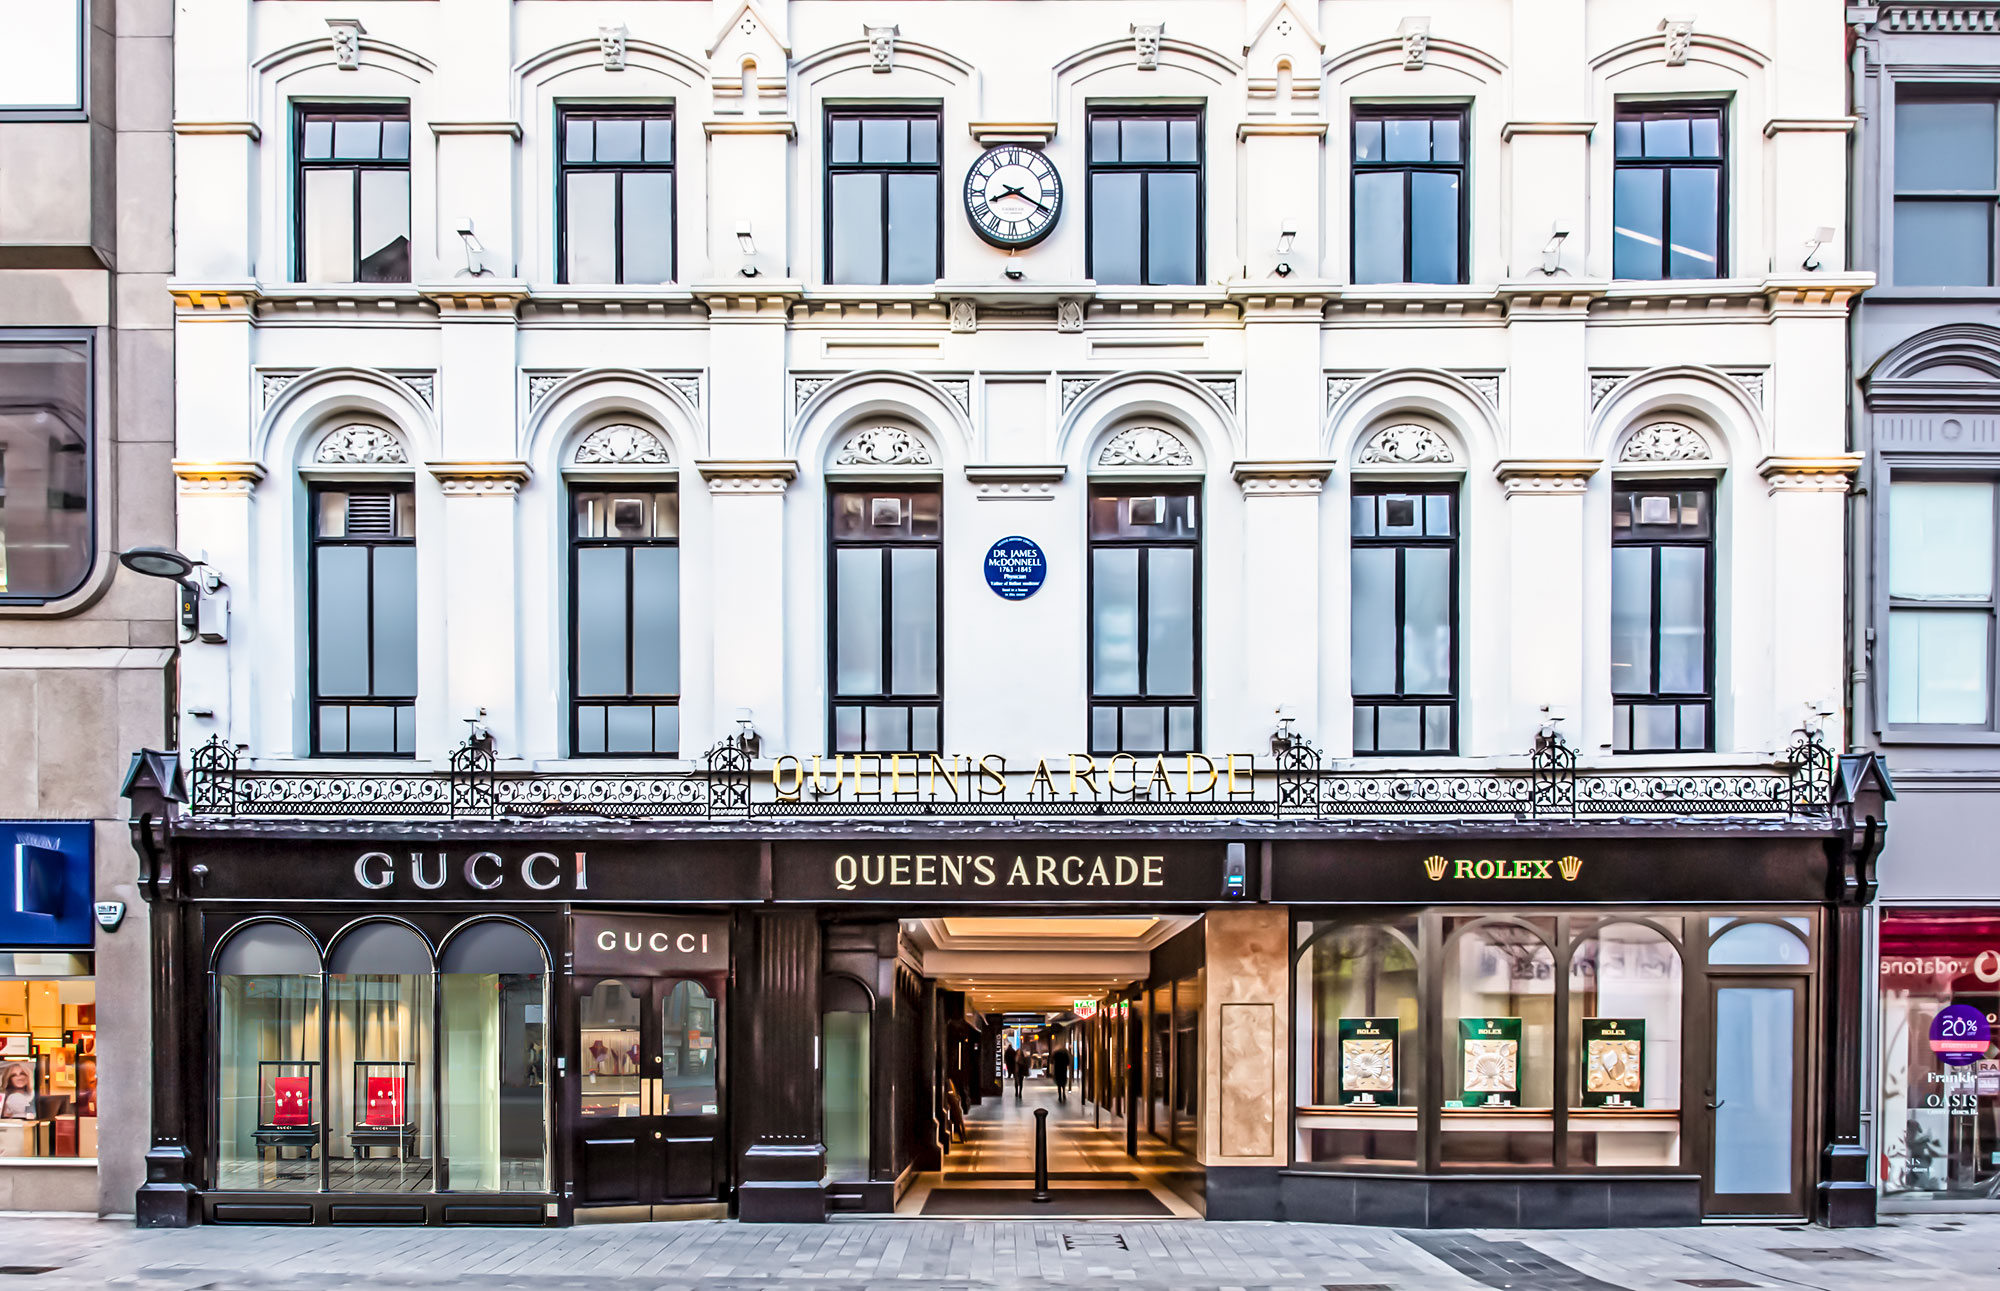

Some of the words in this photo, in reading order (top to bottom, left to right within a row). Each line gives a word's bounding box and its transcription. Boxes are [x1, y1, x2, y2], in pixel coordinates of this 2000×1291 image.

[988, 558, 1042, 566] McDONNELL
[1010, 549, 1037, 558] JAMES
[184, 603, 190, 612] 9
[773, 753, 1007, 801] QUEEN'S
[1028, 753, 1255, 796] ARCADE
[354, 852, 589, 890] GUCCI
[834, 855, 995, 890] QUEEN'S
[1006, 855, 1165, 887] ARCADE
[1453, 859, 1554, 880] ROLEX
[597, 931, 709, 954] GUCCI
[1942, 1019, 1978, 1037] 20%
[1927, 1071, 1978, 1083] Frankie
[1926, 1094, 1978, 1108] OASIS
